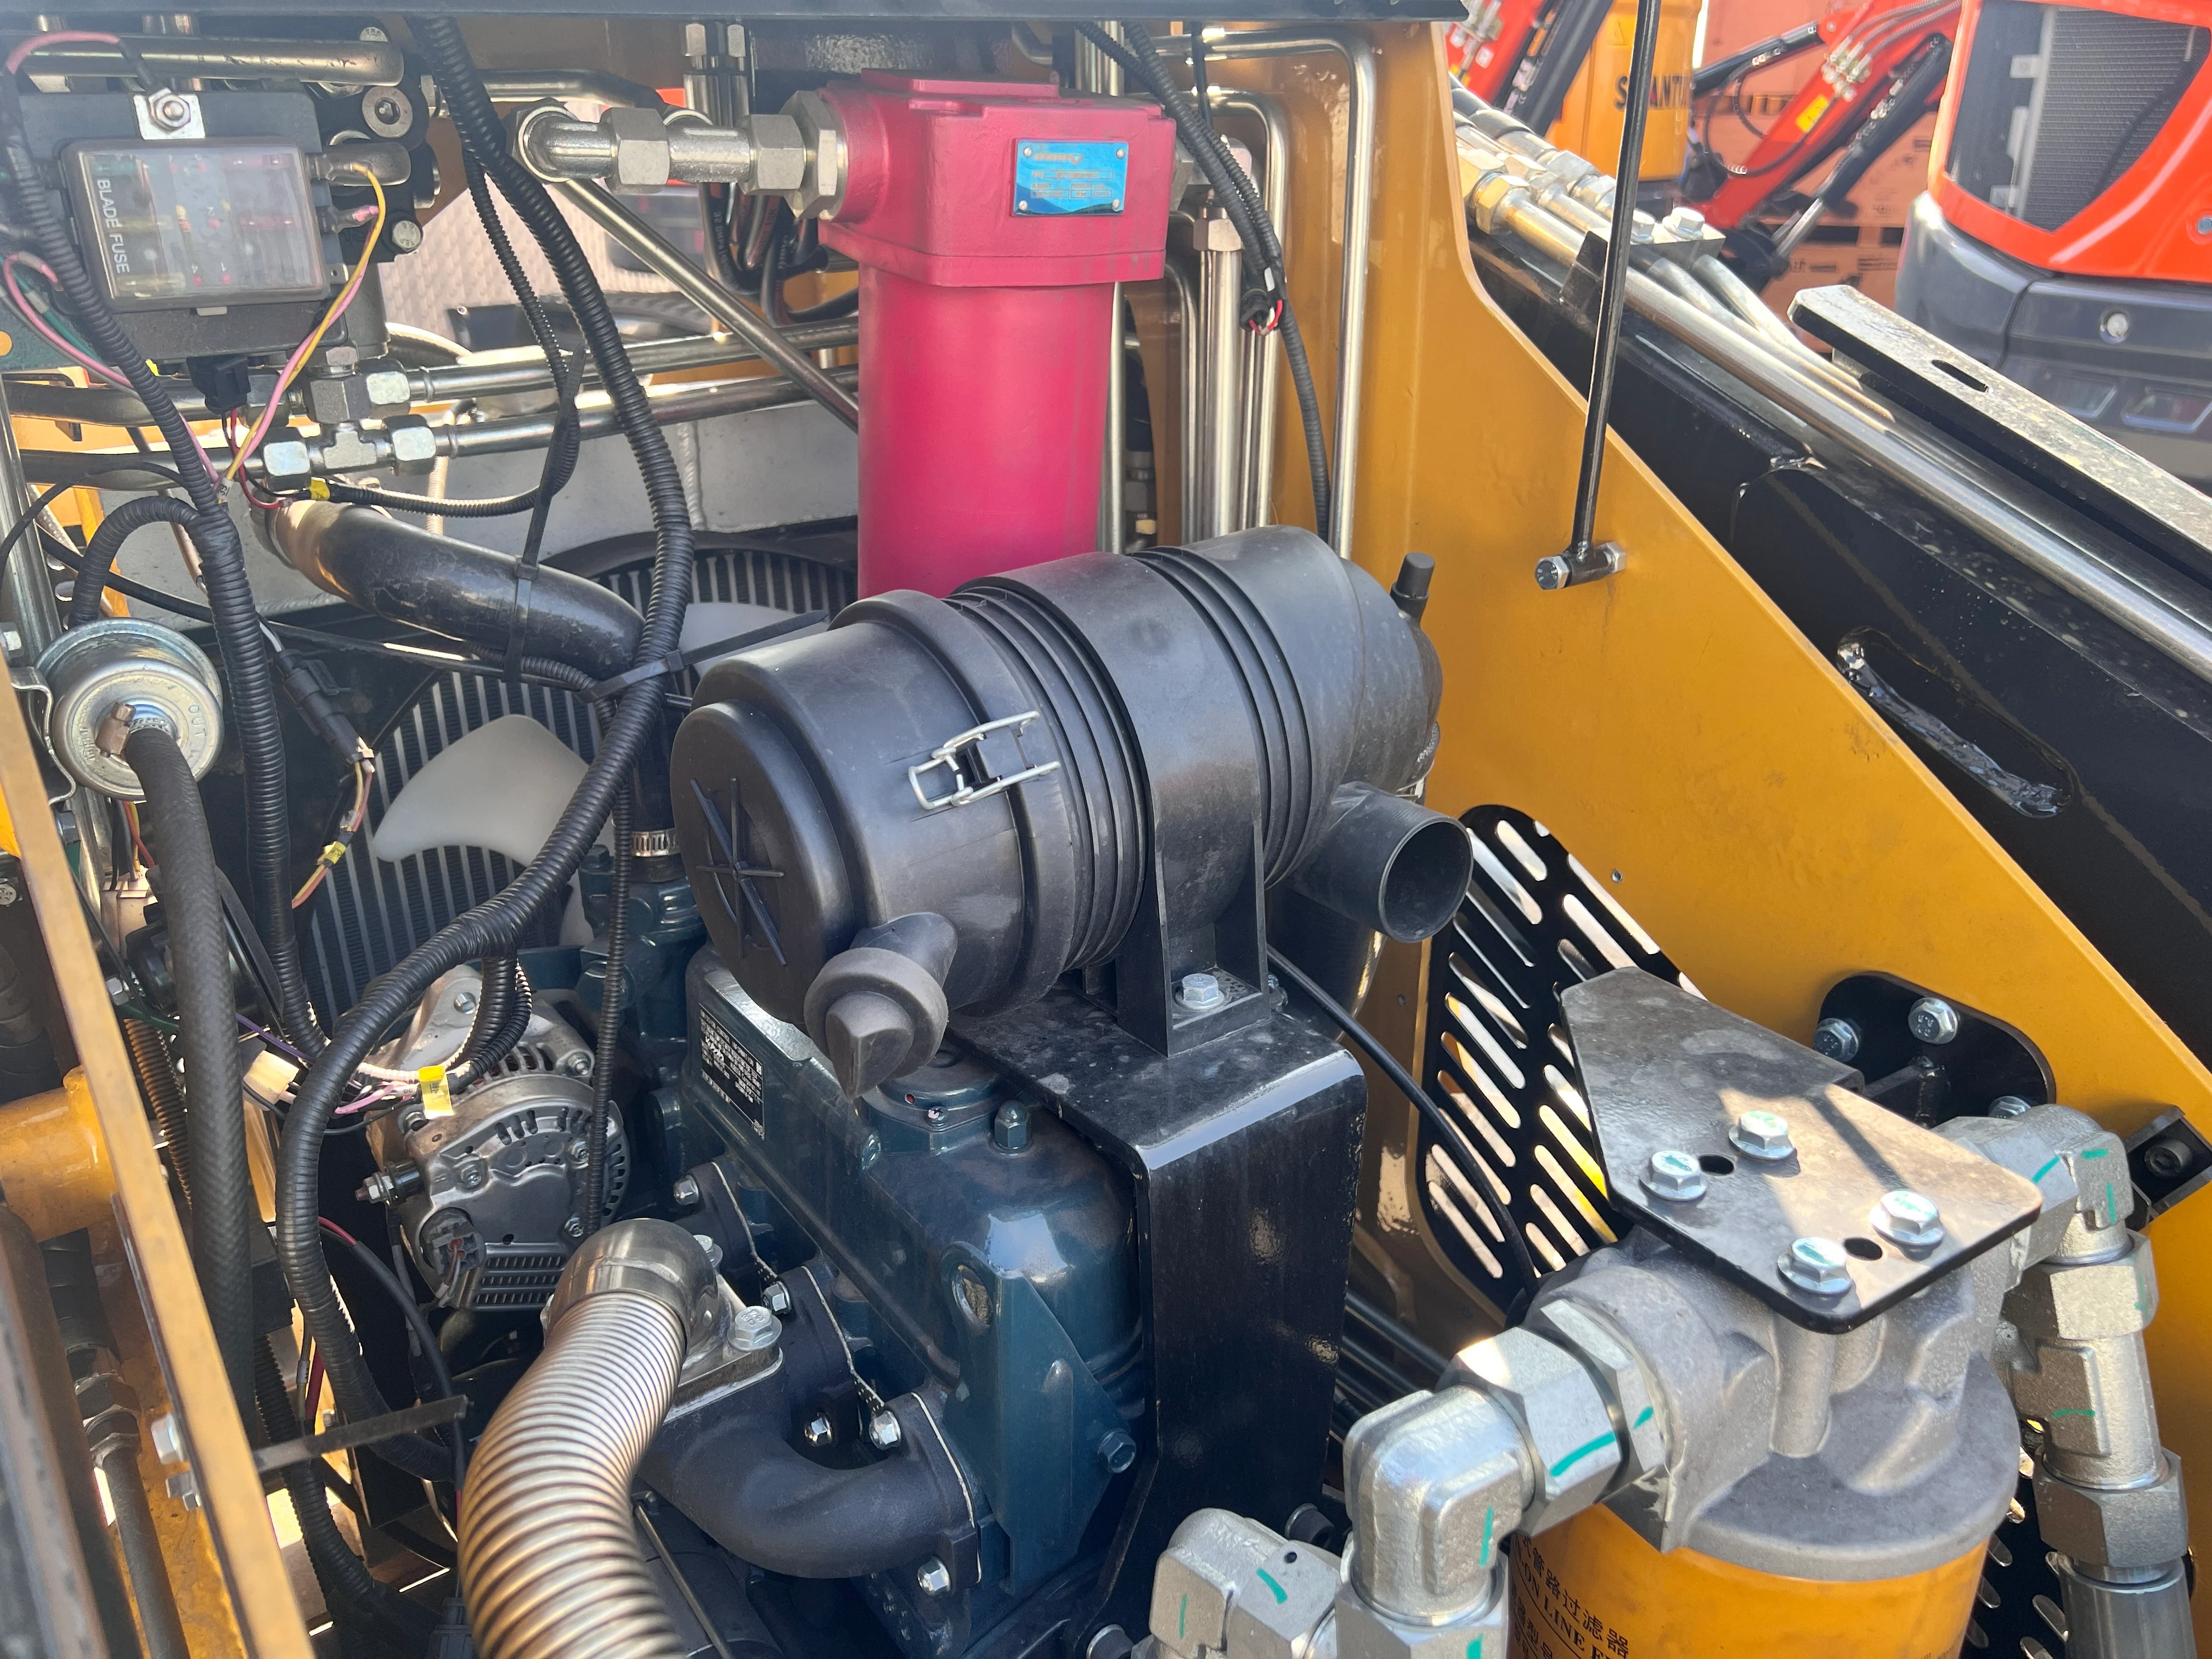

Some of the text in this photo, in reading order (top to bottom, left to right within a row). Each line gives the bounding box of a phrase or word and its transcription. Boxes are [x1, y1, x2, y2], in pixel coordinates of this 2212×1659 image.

[97, 178, 131, 274] BLADE FUSE
[189, 705, 207, 737] OUT
[1544, 1594, 1585, 1652] LINE
